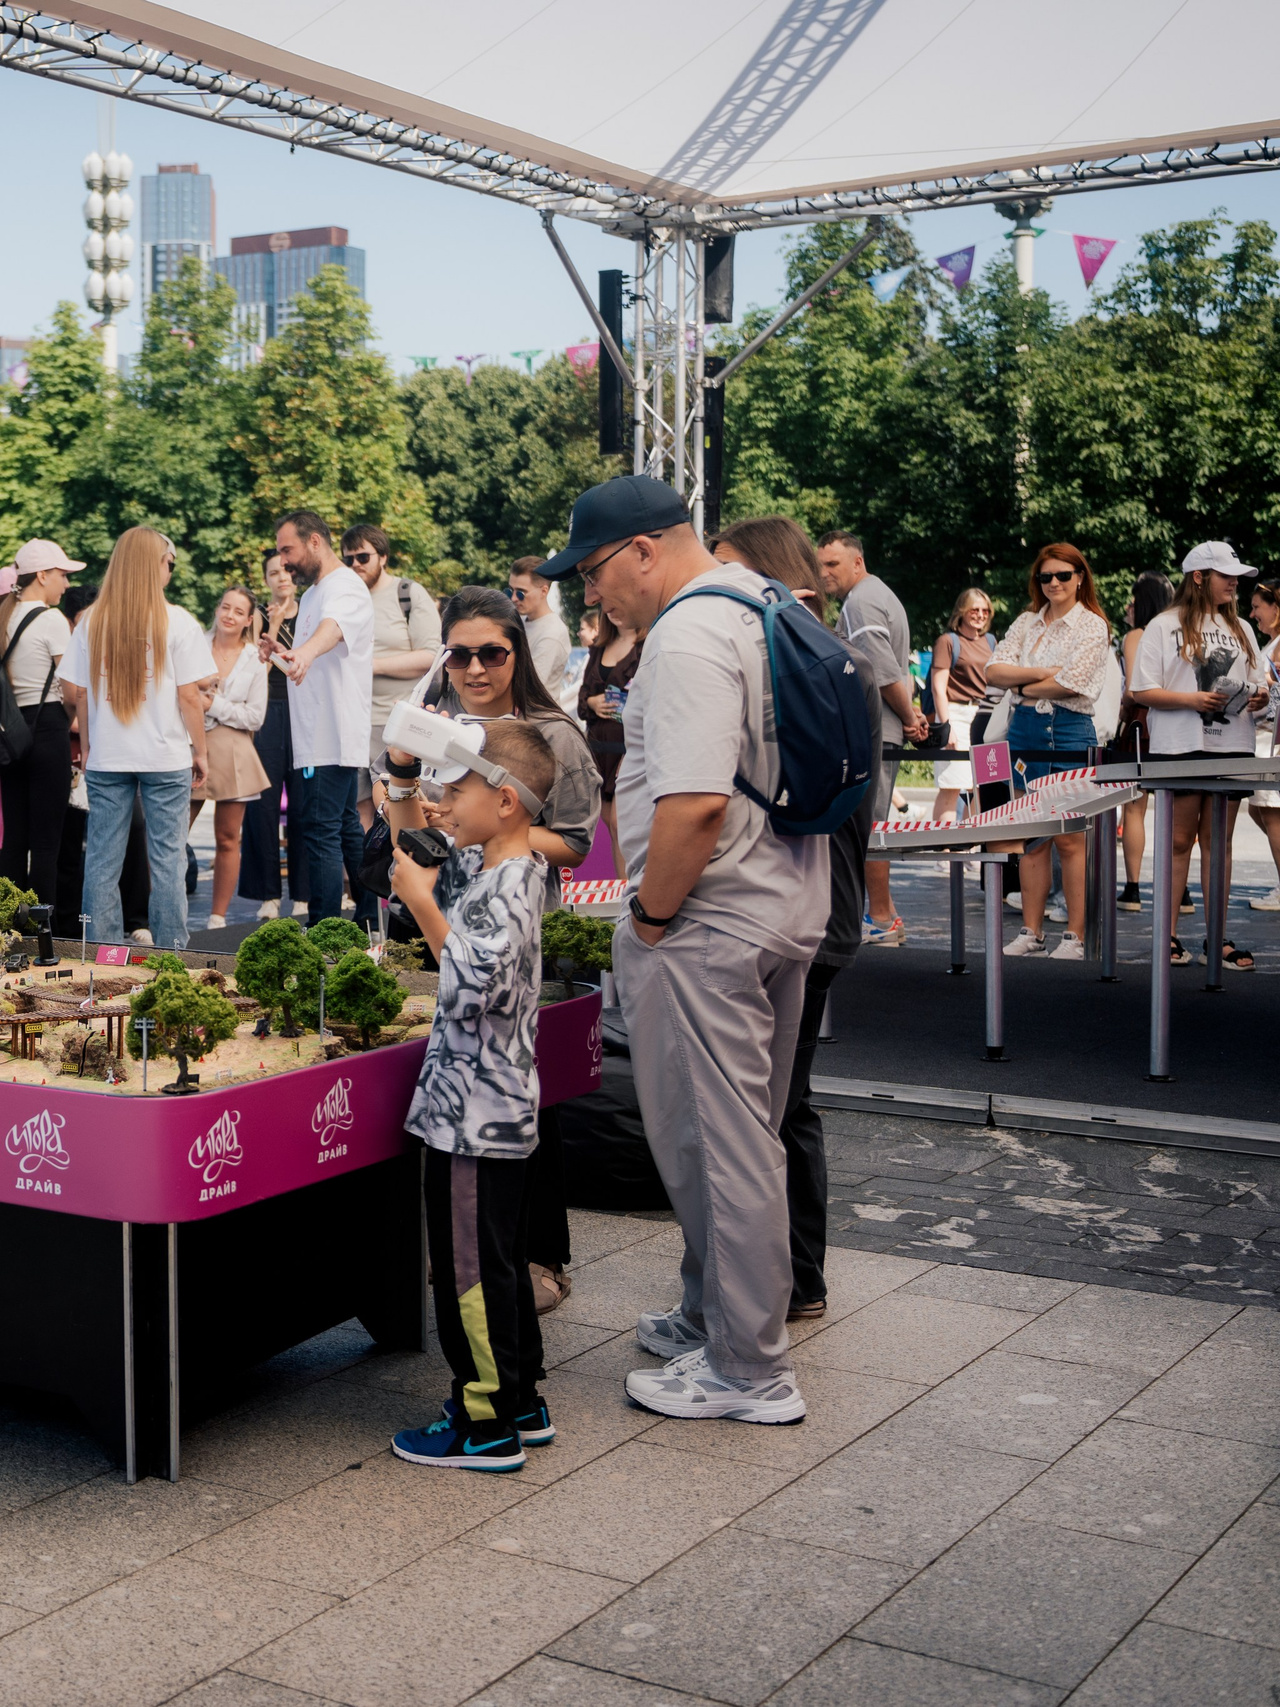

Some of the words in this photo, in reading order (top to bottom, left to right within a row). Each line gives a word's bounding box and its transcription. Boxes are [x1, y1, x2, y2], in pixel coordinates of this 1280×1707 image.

[317, 1143, 348, 1164] ДРАЙВ
[15, 1177, 62, 1195] ДРАЙВ
[199, 1180, 237, 1202] ДРАЙВ
